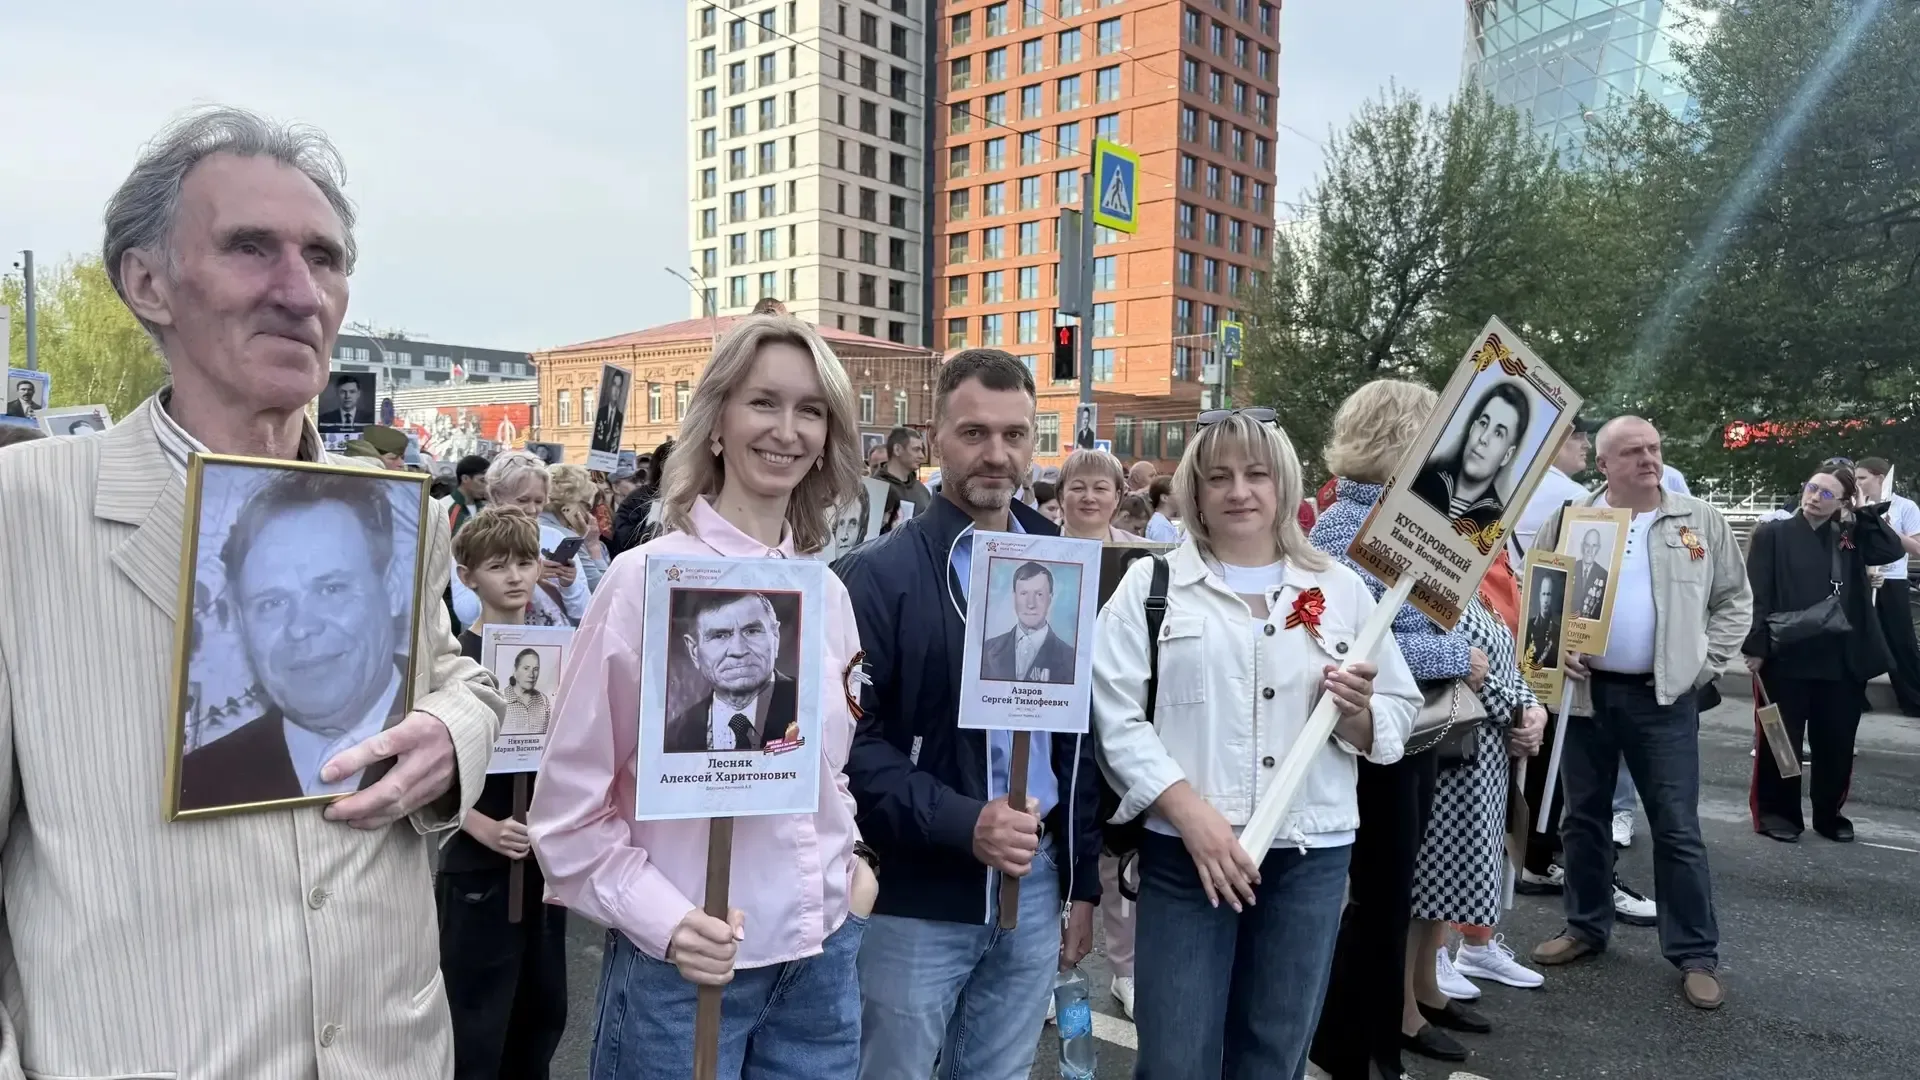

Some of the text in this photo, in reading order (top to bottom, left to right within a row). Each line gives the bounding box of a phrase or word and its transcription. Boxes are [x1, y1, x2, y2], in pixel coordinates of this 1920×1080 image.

[1394, 512, 1472, 573] КУСТАРОВСКИЙ
[1390, 526, 1462, 583] Иван Иосифович
[1368, 536, 1413, 571] 20.06.1927
[1420, 571, 1460, 606] 21.04.1998
[1011, 686, 1042, 696] Азаров
[981, 695, 1069, 707] Сергей Тимофеевич
[707, 758, 753, 768] Лесняк
[660, 771, 797, 783] Алексей Харитонович
